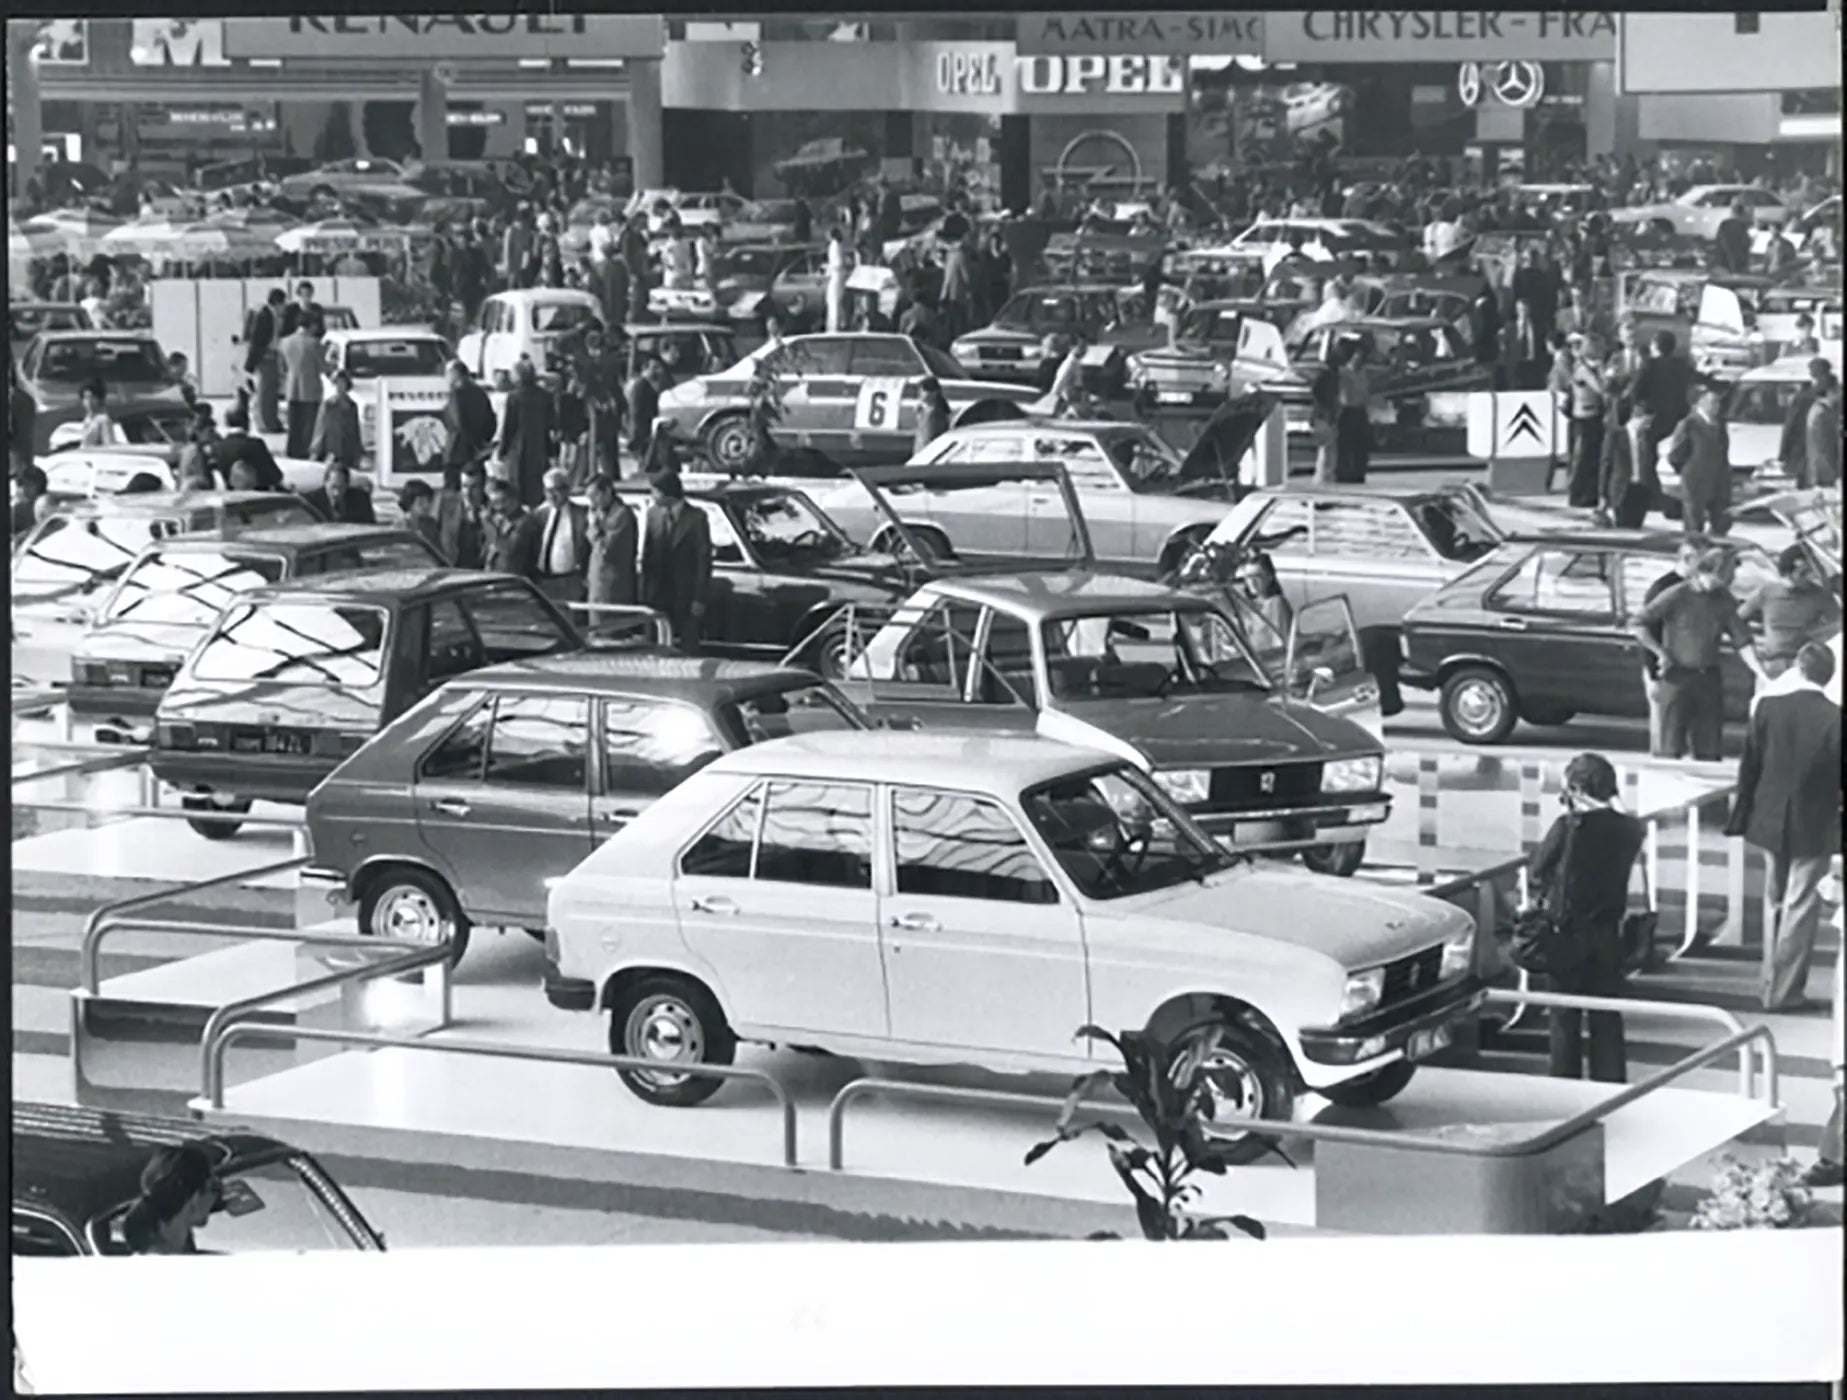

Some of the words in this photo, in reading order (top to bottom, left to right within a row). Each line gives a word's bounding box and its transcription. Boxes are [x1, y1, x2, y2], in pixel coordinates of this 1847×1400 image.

[936, 51, 998, 95] OPEL
[1016, 54, 1184, 93] OPEL
[868, 390, 889, 427] 6
